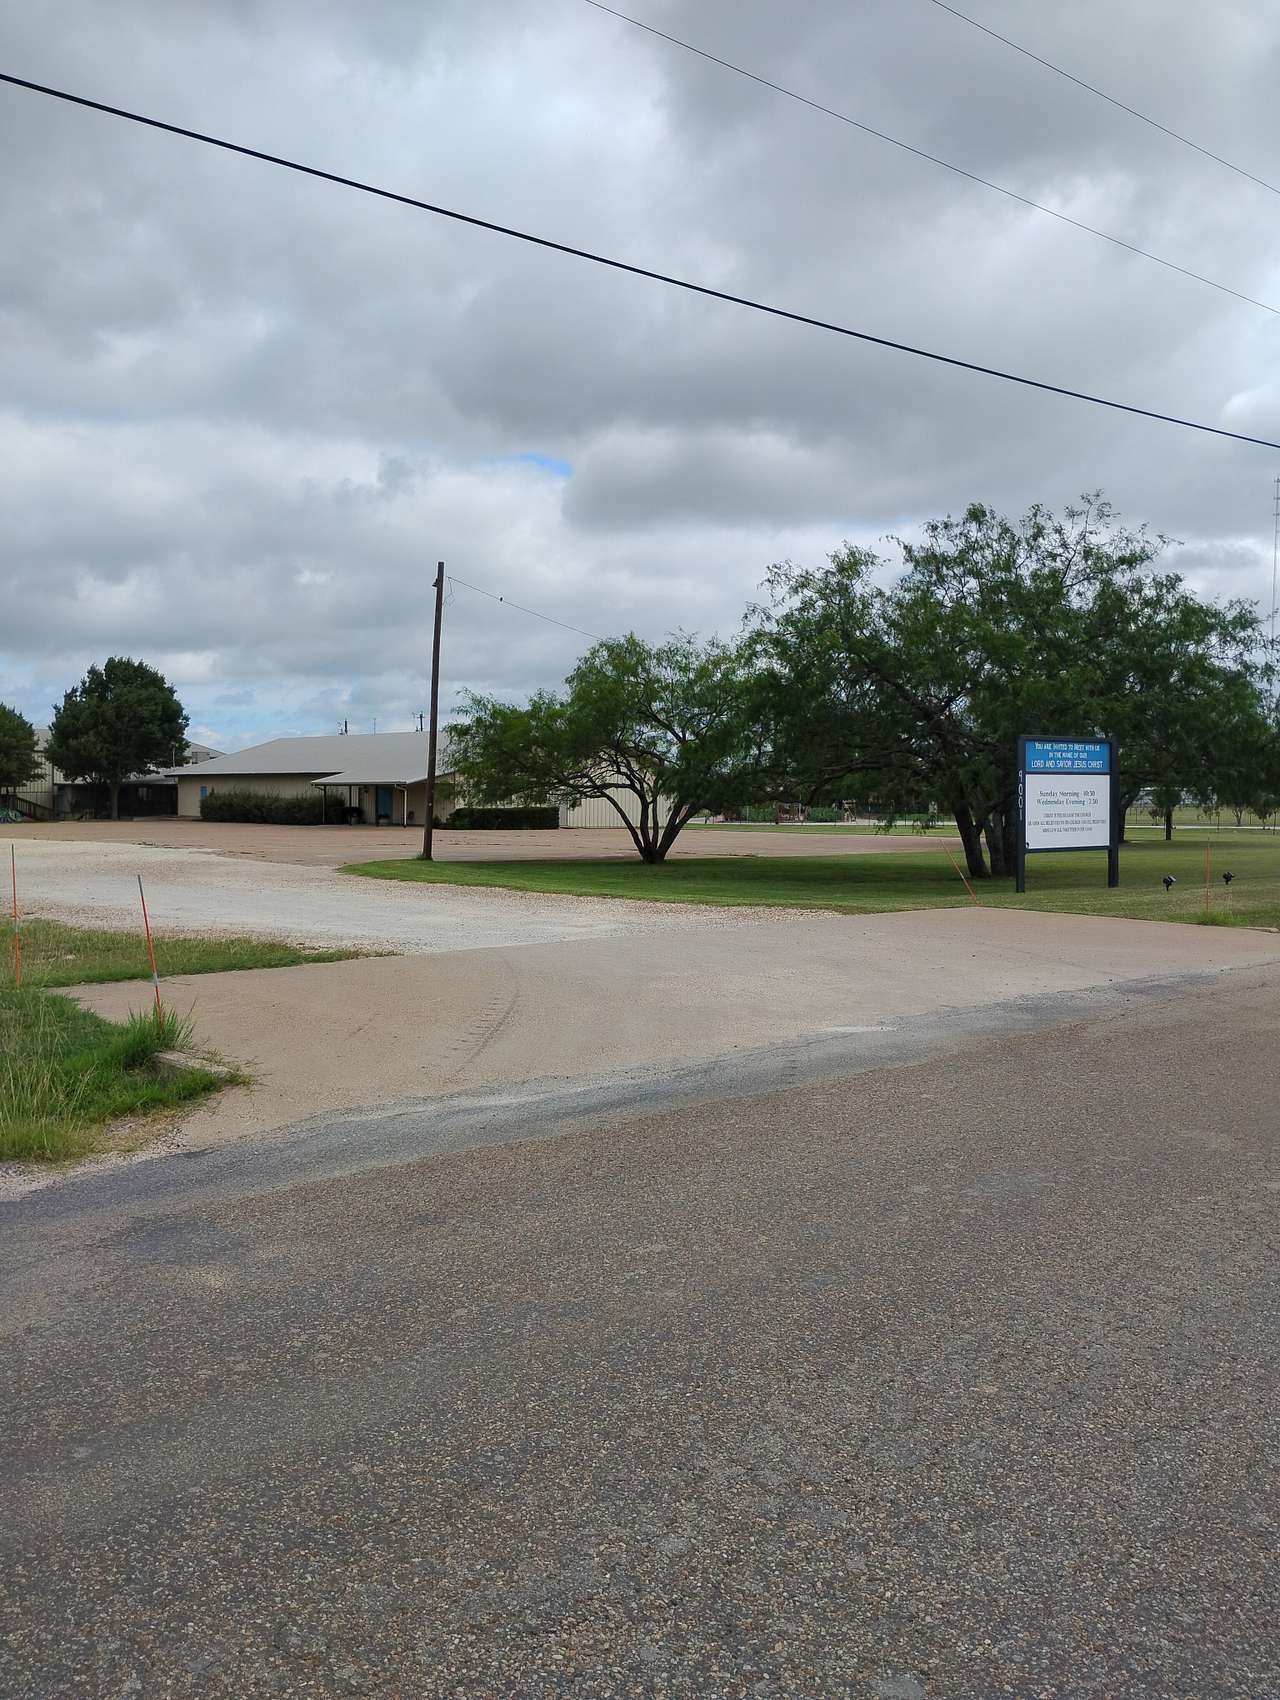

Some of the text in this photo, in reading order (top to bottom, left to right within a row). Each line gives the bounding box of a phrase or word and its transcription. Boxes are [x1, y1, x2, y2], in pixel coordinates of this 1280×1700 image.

[1031, 760, 1104, 768] LORD AND SAVIOR JESUS CHRIST
[1065, 798, 1086, 806] Evening
